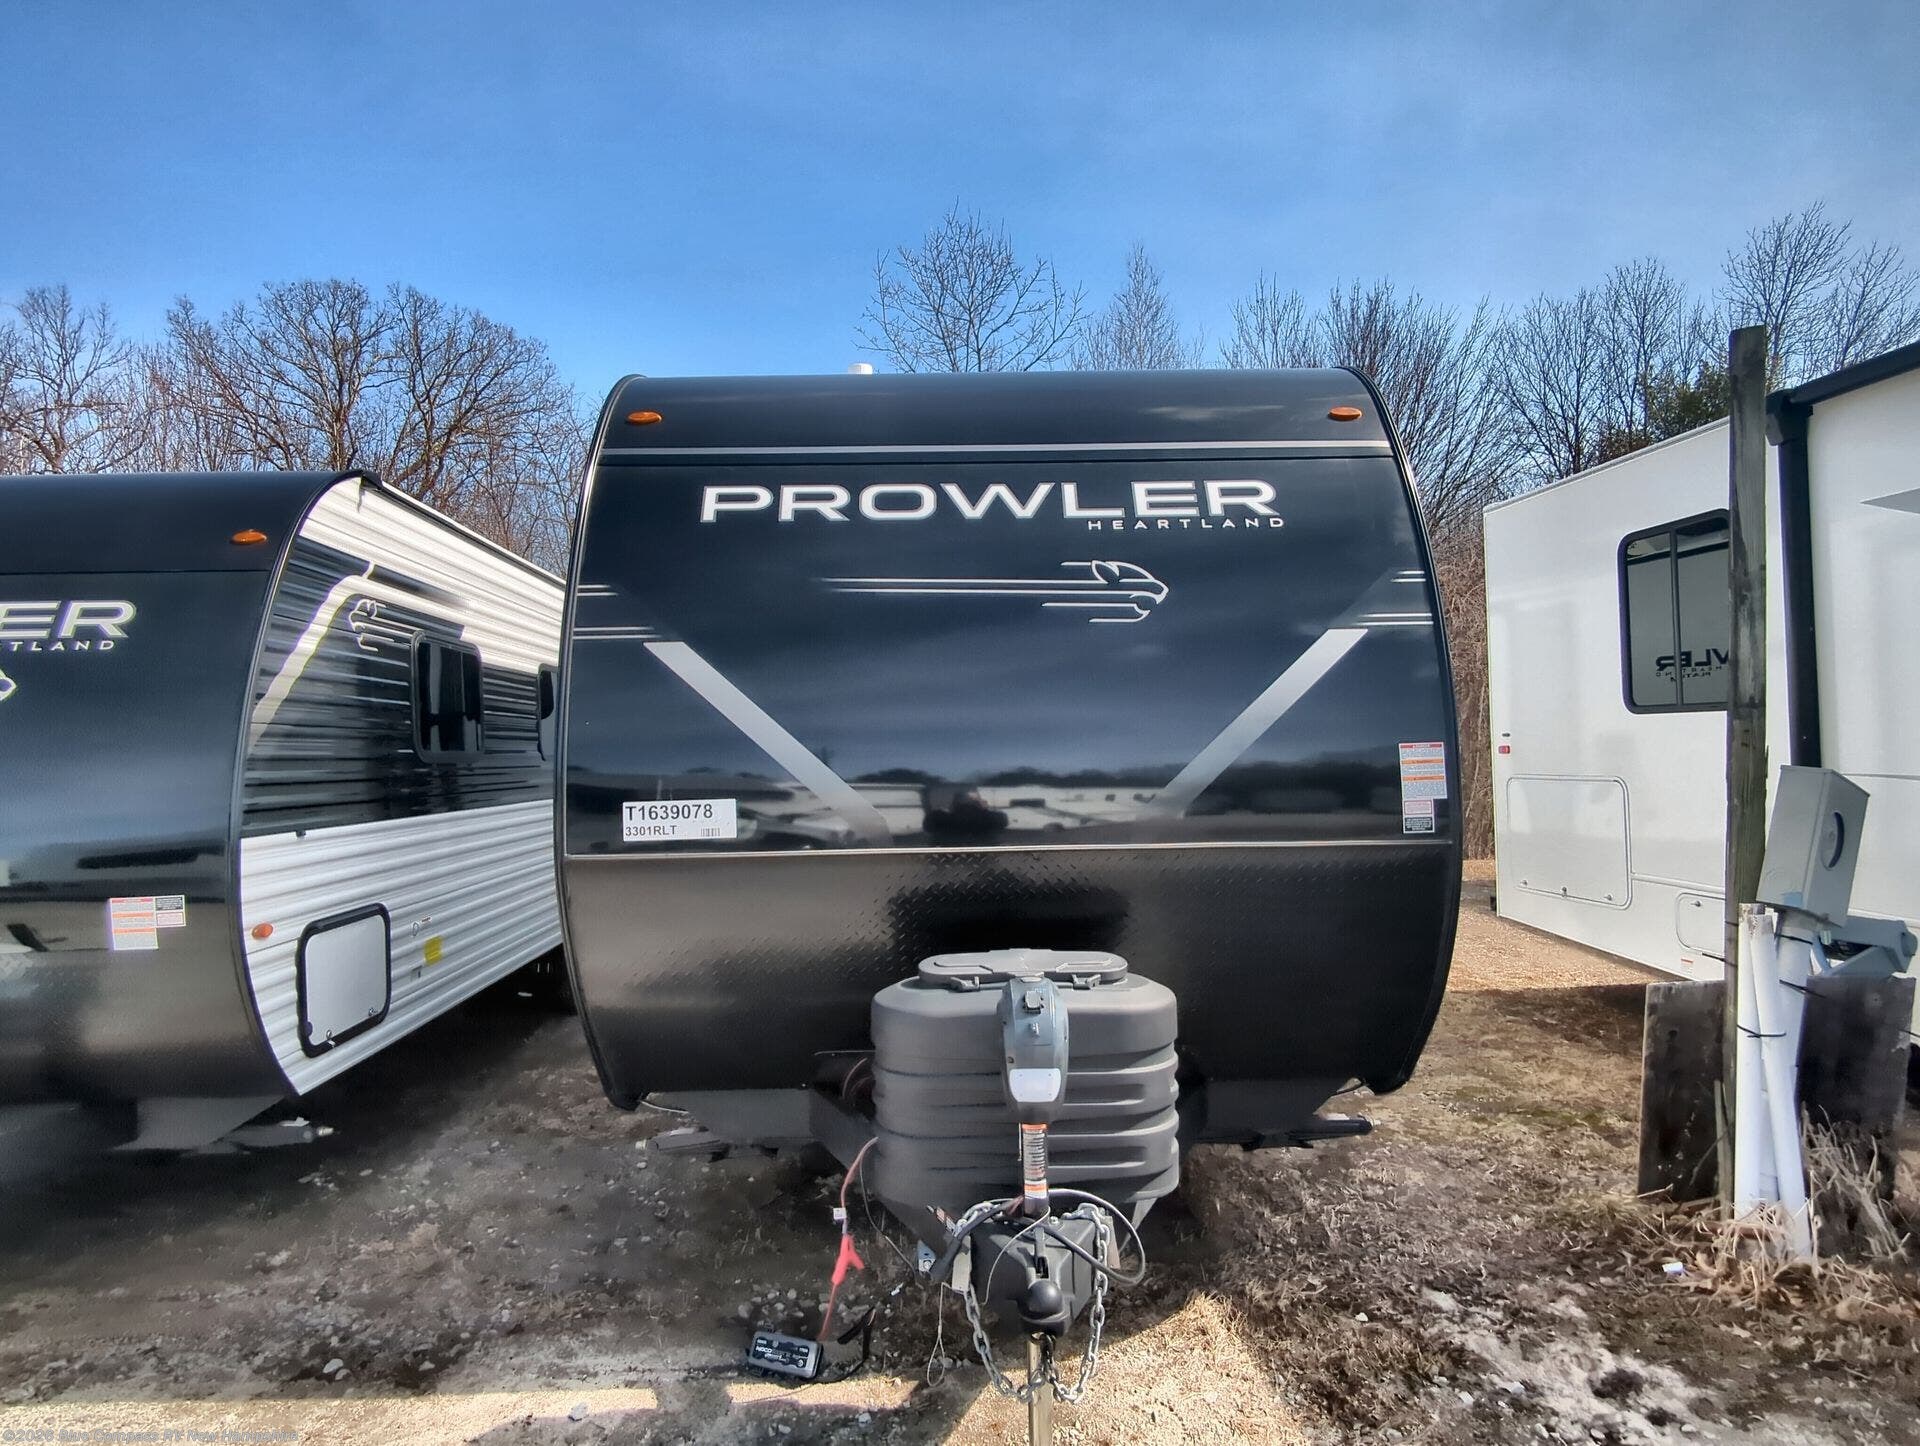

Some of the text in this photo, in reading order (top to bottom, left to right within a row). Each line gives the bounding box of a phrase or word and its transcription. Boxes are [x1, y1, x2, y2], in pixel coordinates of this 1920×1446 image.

[700, 481, 1280, 523] PROWLER
[1088, 518, 1285, 530] HEARTLAND
[0, 640, 115, 652] TLAND
[625, 803, 713, 821] T1639078
[625, 825, 677, 837] 3301RLT
